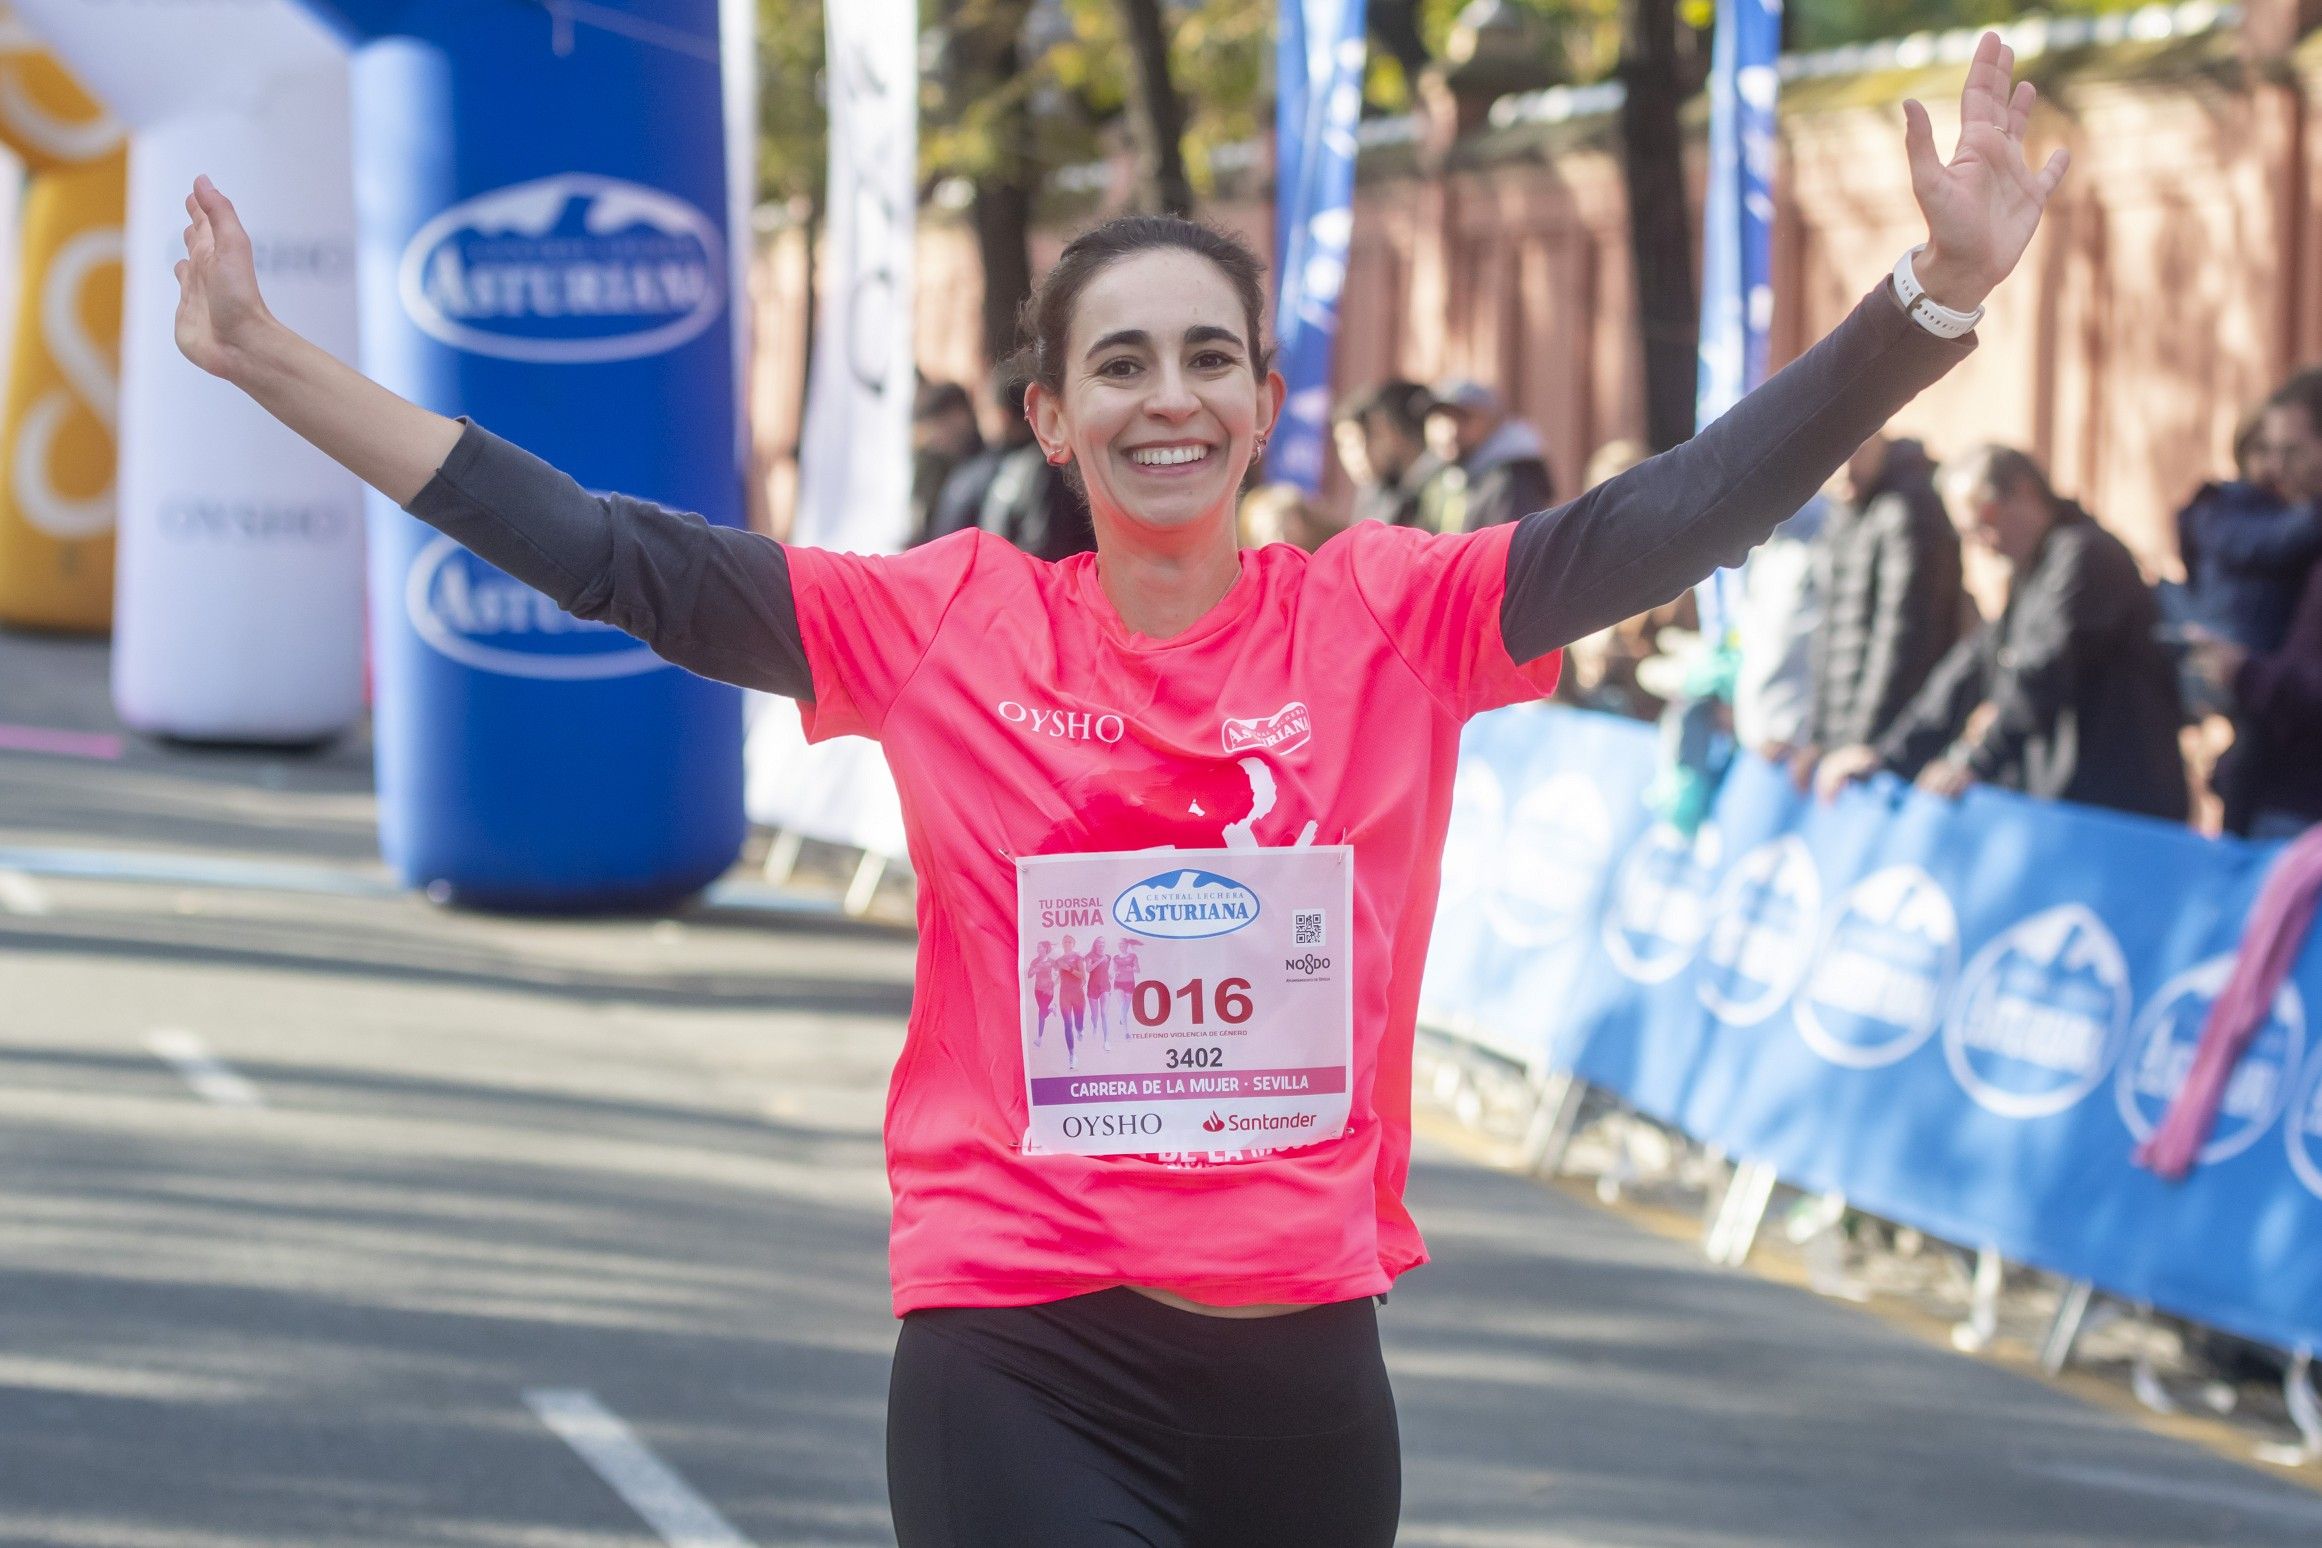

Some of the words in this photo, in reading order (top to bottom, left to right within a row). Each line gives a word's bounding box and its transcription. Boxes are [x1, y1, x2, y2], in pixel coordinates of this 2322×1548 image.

[998, 700, 1125, 743] OYSHO
[1039, 900, 1053, 910] TU
[1056, 897, 1103, 909] DORSAL
[1146, 893, 1193, 901] CENTRAL
[1197, 891, 1244, 900] LECHERA
[1041, 909, 1105, 928] SUMA
[1123, 896, 1250, 923] ASTURIANA
[1131, 977, 1254, 1027] 016
[1132, 1032, 1169, 1040] TELÉFONO
[1170, 1030, 1208, 1039] VIOLENCIA
[1219, 1029, 1248, 1037] GÉNERO
[1165, 1047, 1223, 1069] 3402
[1070, 1080, 1138, 1097] CARRERA
[1142, 1079, 1162, 1095] DE
[1166, 1079, 1184, 1094] LA
[1190, 1077, 1239, 1093] MUJER
[1253, 1075, 1309, 1091] SEVILLA
[1062, 1113, 1162, 1138] OYSHO
[1228, 1112, 1318, 1132] Santander
